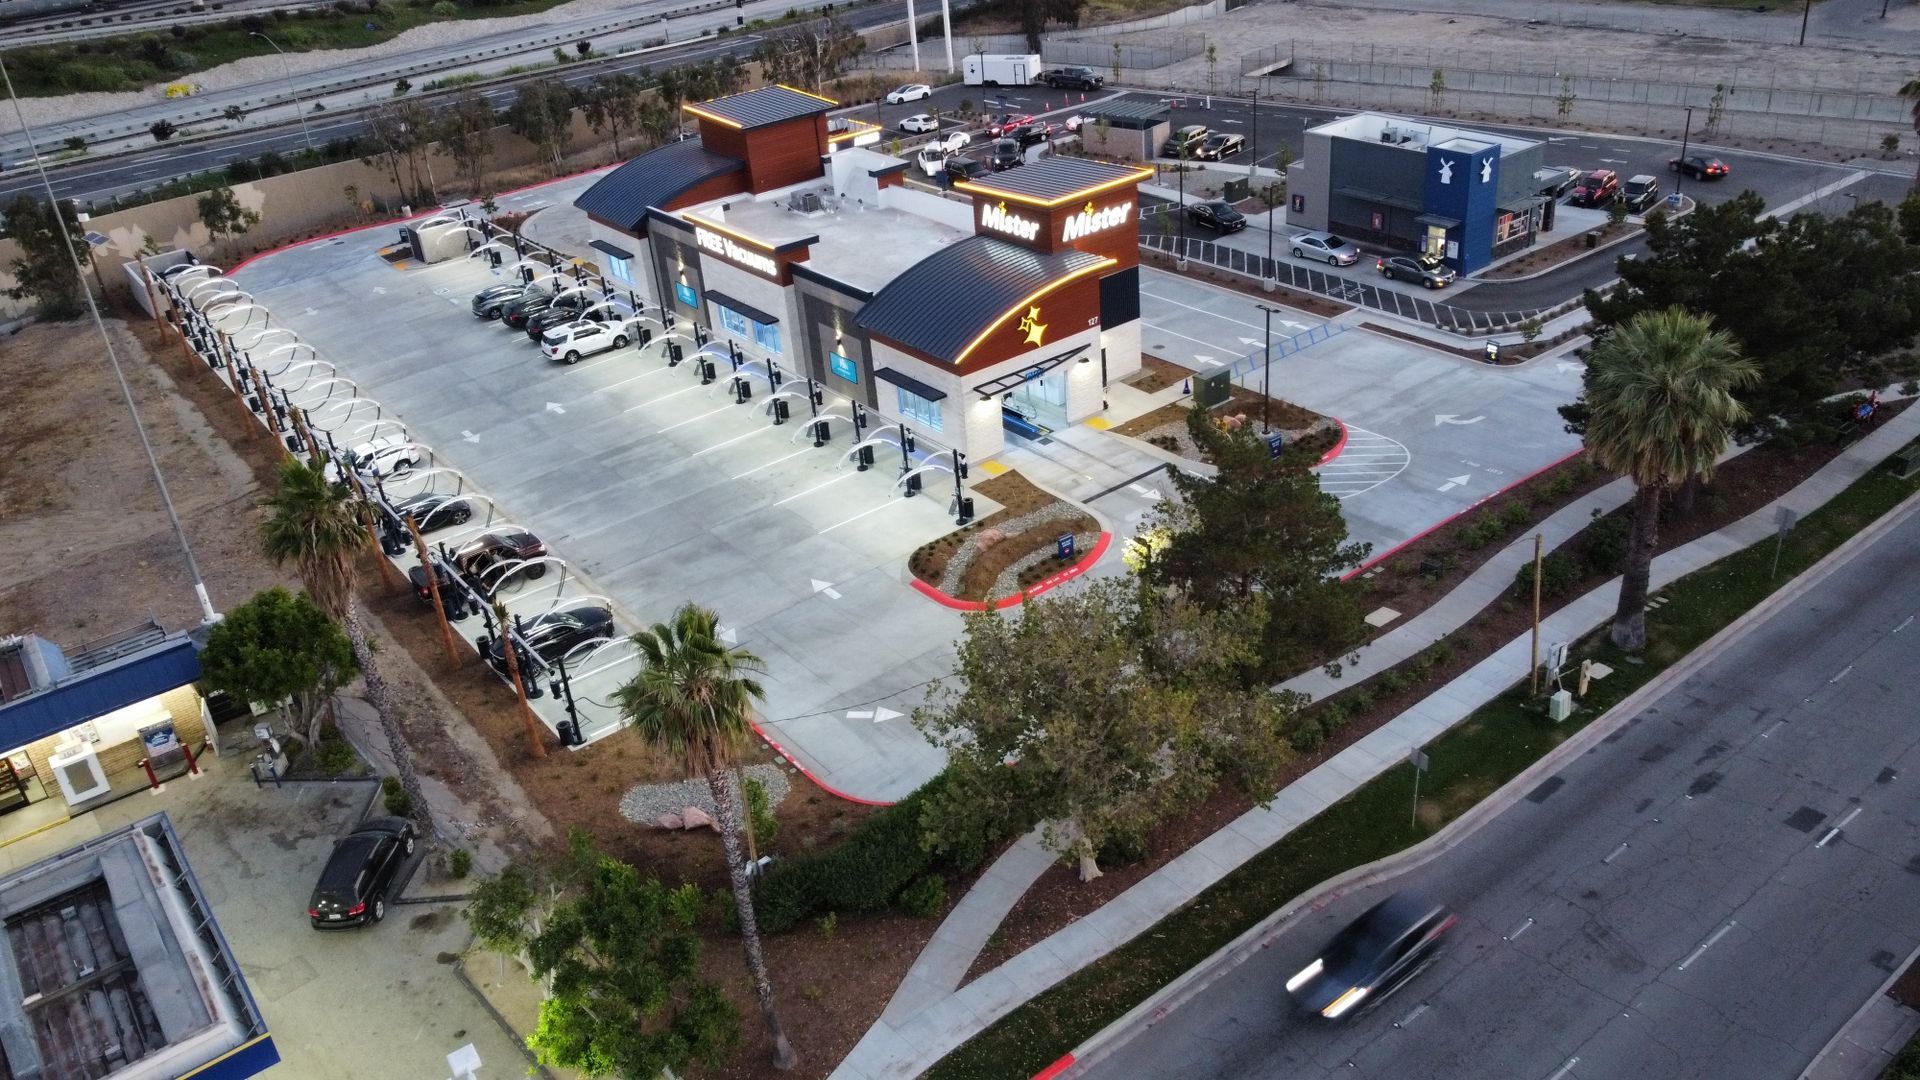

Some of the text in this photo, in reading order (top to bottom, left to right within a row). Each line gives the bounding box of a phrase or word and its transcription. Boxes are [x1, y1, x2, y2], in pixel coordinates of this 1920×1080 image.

[982, 203, 1040, 241] Mister
[1063, 201, 1132, 242] Mister
[695, 226, 777, 276] FREE Vacuums
[1087, 316, 1099, 327] 127
